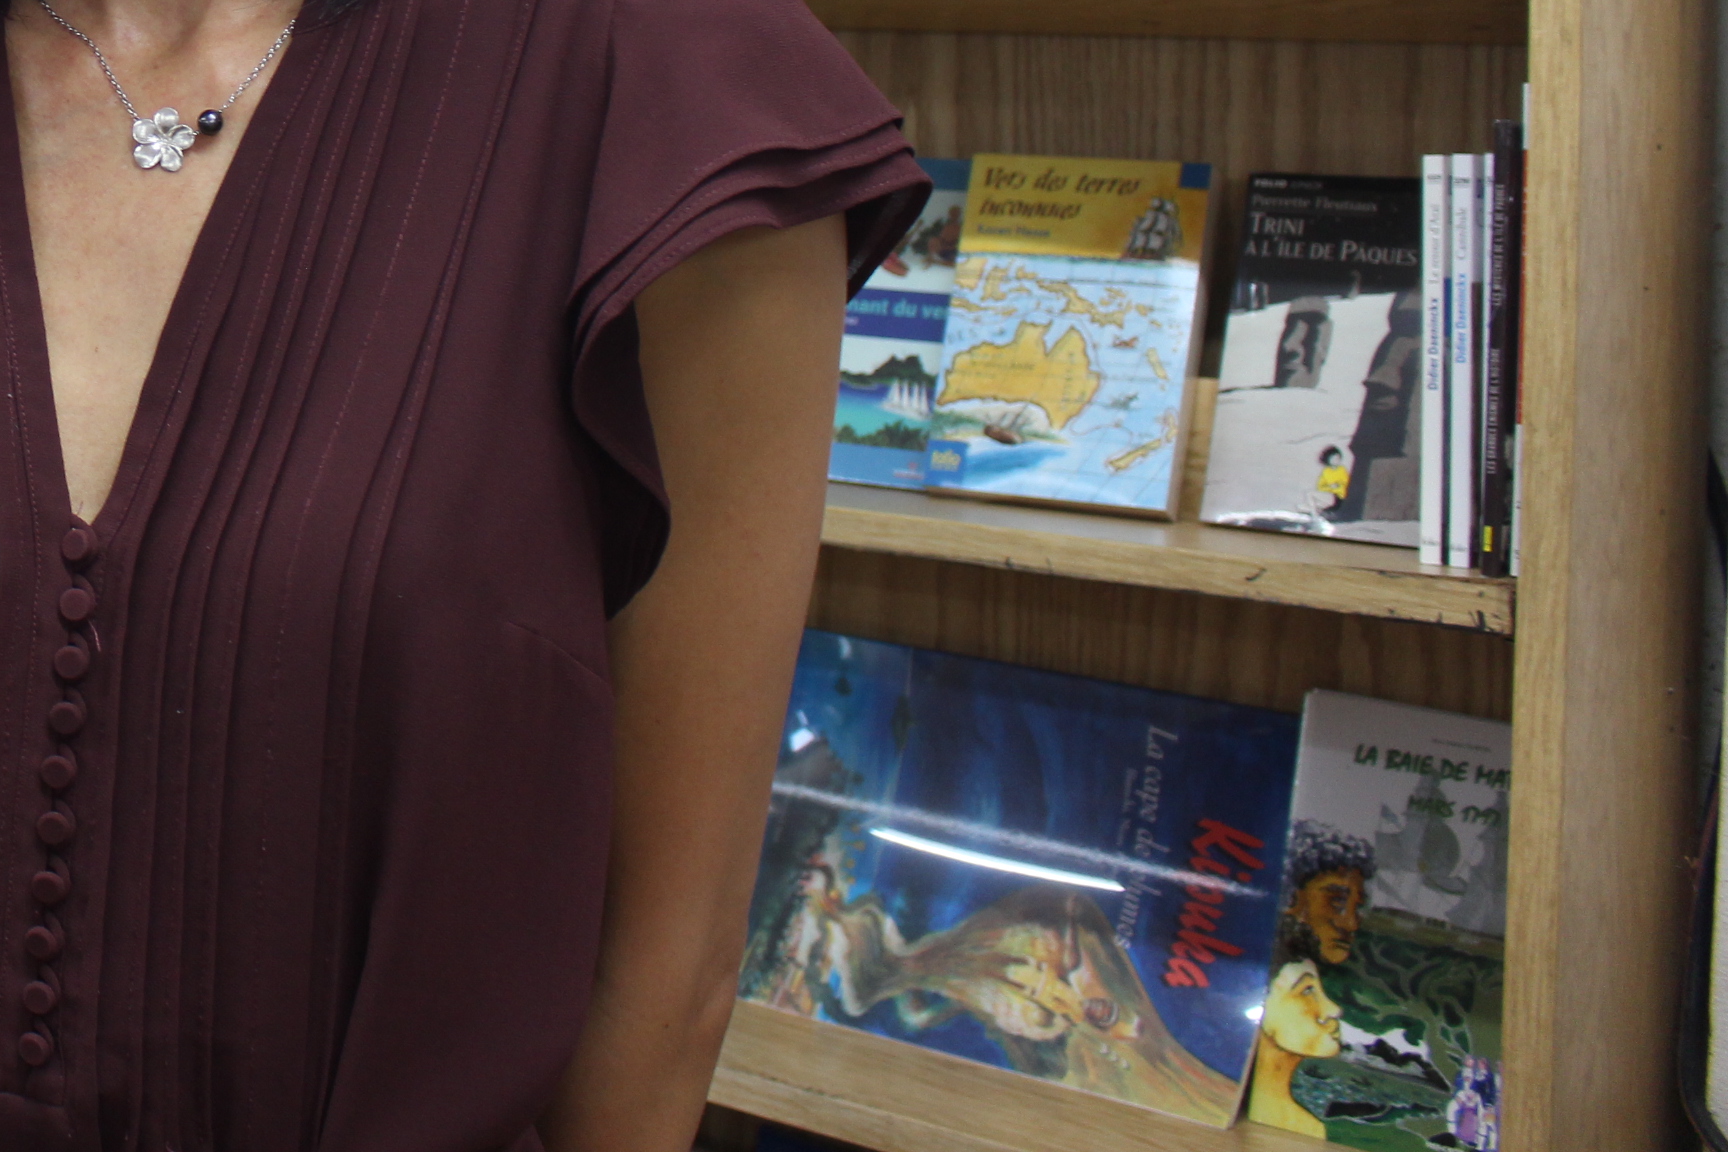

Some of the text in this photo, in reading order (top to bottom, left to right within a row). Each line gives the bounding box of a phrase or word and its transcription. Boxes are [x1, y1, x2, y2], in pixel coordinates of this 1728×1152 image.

[984, 166, 1142, 196] Vers des terres
[979, 197, 1082, 220] inconnues
[1310, 242, 1336, 261] DE
[1146, 725, 1178, 759] La
[1354, 742, 1379, 766] LA
[1385, 747, 1434, 776] BAIE
[1440, 757, 1470, 782] DE
[1134, 764, 1161, 823] cape
[1134, 828, 1171, 858] de
